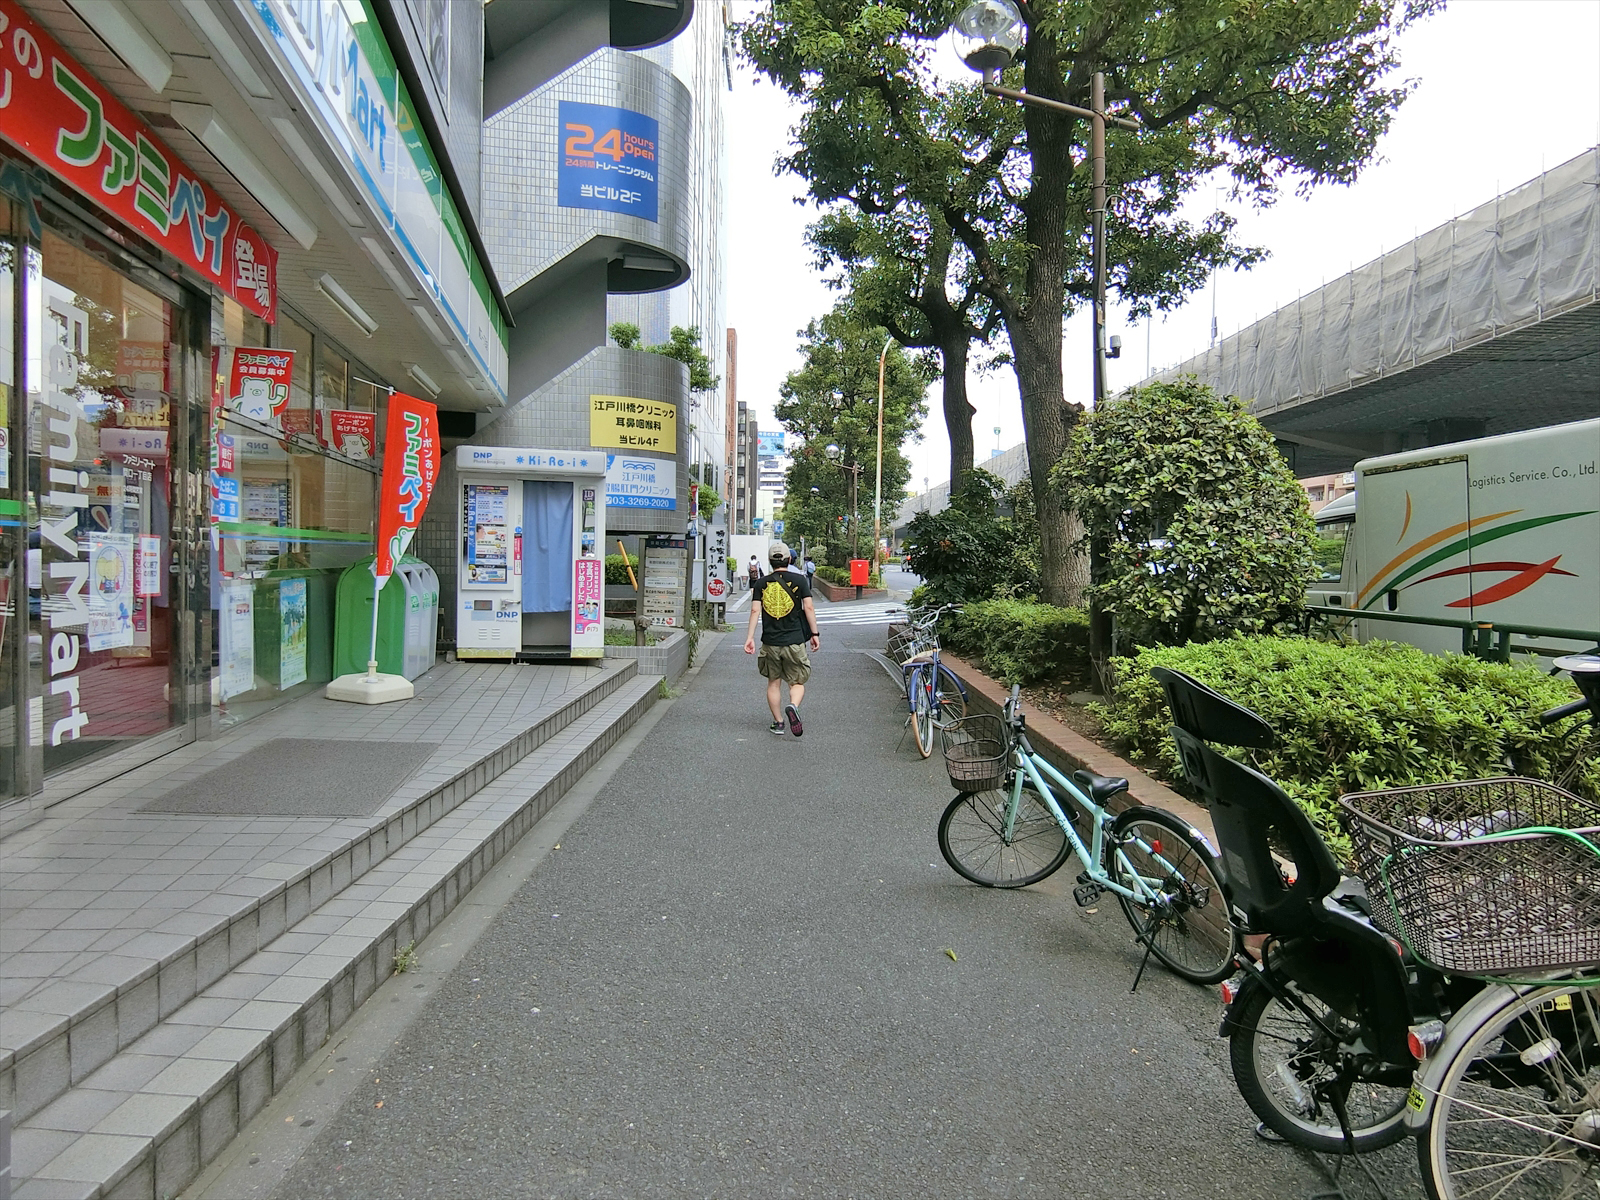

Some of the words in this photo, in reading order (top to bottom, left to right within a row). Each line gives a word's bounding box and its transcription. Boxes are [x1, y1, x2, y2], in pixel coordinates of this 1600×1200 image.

[565, 122, 625, 162] 24
[624, 132, 654, 149] hours
[624, 142, 655, 161] Open
[51, 56, 230, 276] ファミペイ
[565, 157, 654, 182] 24時間トレーニングジム
[580, 184, 642, 204] 当ビル2F
[235, 238, 270, 308] 登場
[238, 353, 290, 368] ファミペイ
[594, 400, 675, 419] 江戸川橋クリニック
[336, 425, 371, 435] あげちゃう
[338, 417, 368, 427] クーポン
[616, 417, 662, 431] 耳鼻咽喉科
[619, 435, 660, 447] 当ビル4F
[399, 411, 423, 522] ファミペイ
[422, 417, 434, 508] クーポンあげち
[1579, 461, 1599, 476] Ltd.
[622, 472, 656, 484] 江戸川橋
[612, 496, 670, 508] 03-3269-2020
[41, 295, 90, 748] FamilyMart
[708, 545, 718, 578] らーめん
[496, 611, 518, 619] DNP
